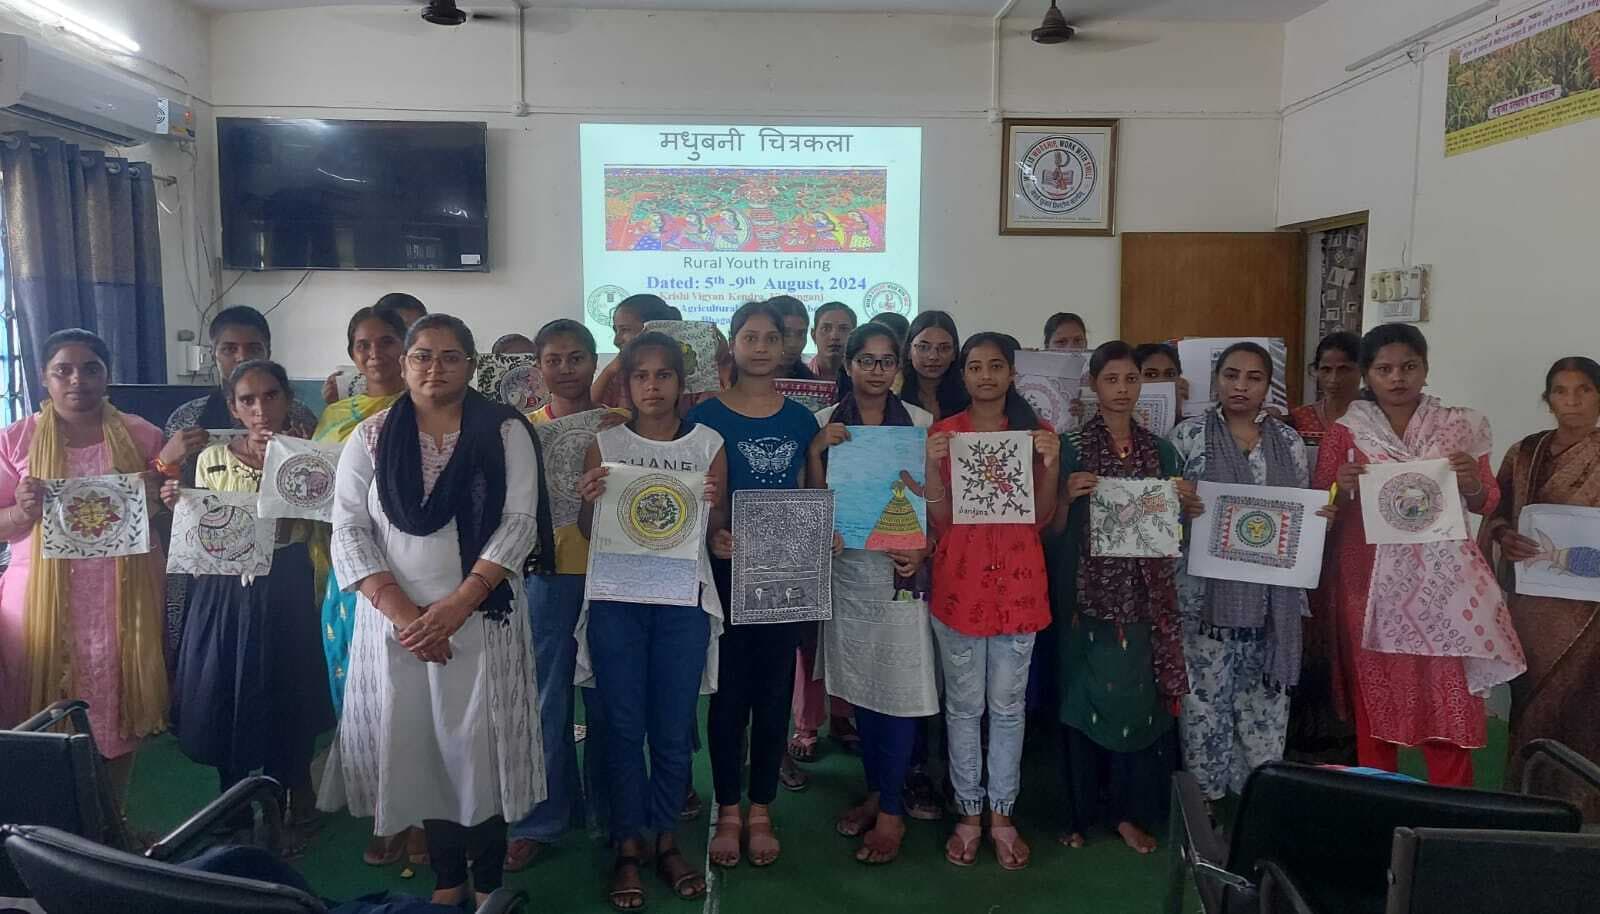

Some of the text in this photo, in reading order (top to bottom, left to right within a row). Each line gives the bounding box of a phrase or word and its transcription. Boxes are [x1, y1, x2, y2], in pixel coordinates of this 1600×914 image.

[659, 127, 854, 161] मधुबनी चित्रकला
[1059, 140, 1076, 151] WORK
[1075, 147, 1089, 161] WITH
[683, 256, 831, 272] Rural Youth training
[647, 276, 699, 289] Dated:
[763, 277, 824, 292] August,
[829, 277, 867, 289] 2024
[659, 291, 689, 301] Krishi
[692, 292, 726, 303] Vigyan
